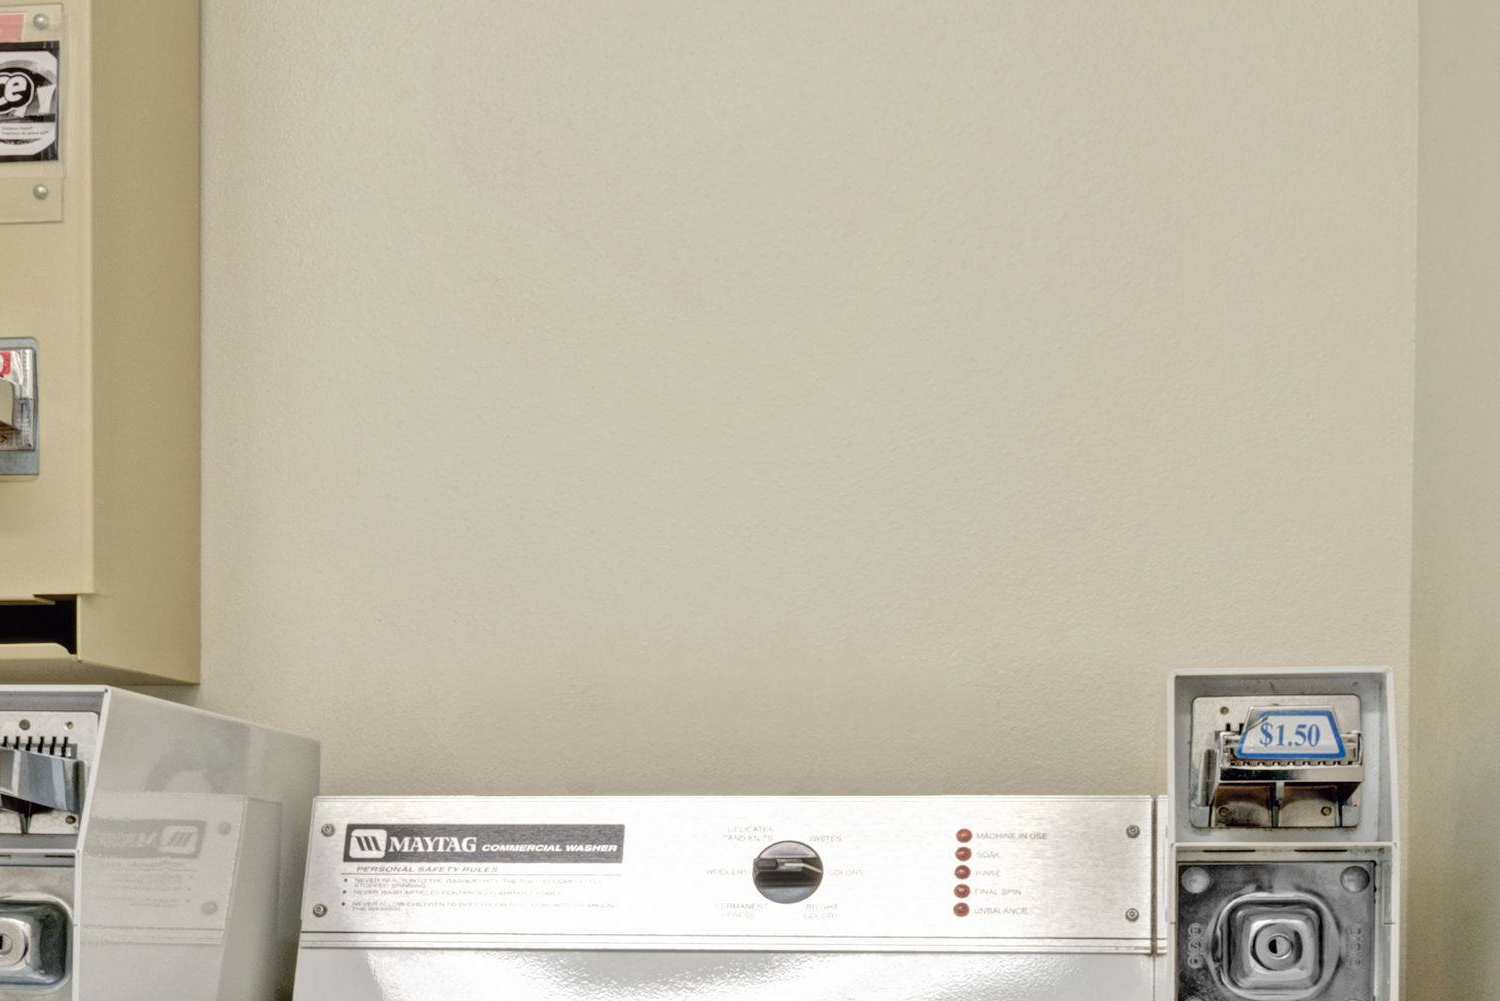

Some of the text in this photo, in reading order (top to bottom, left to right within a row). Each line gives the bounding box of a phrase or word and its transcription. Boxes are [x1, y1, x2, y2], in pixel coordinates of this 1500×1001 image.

[1259, 722, 1321, 749] $1.50
[976, 832, 1048, 840] MACHINE IN USE
[389, 837, 618, 853] MAYTAG COMMERCIAL WASHER
